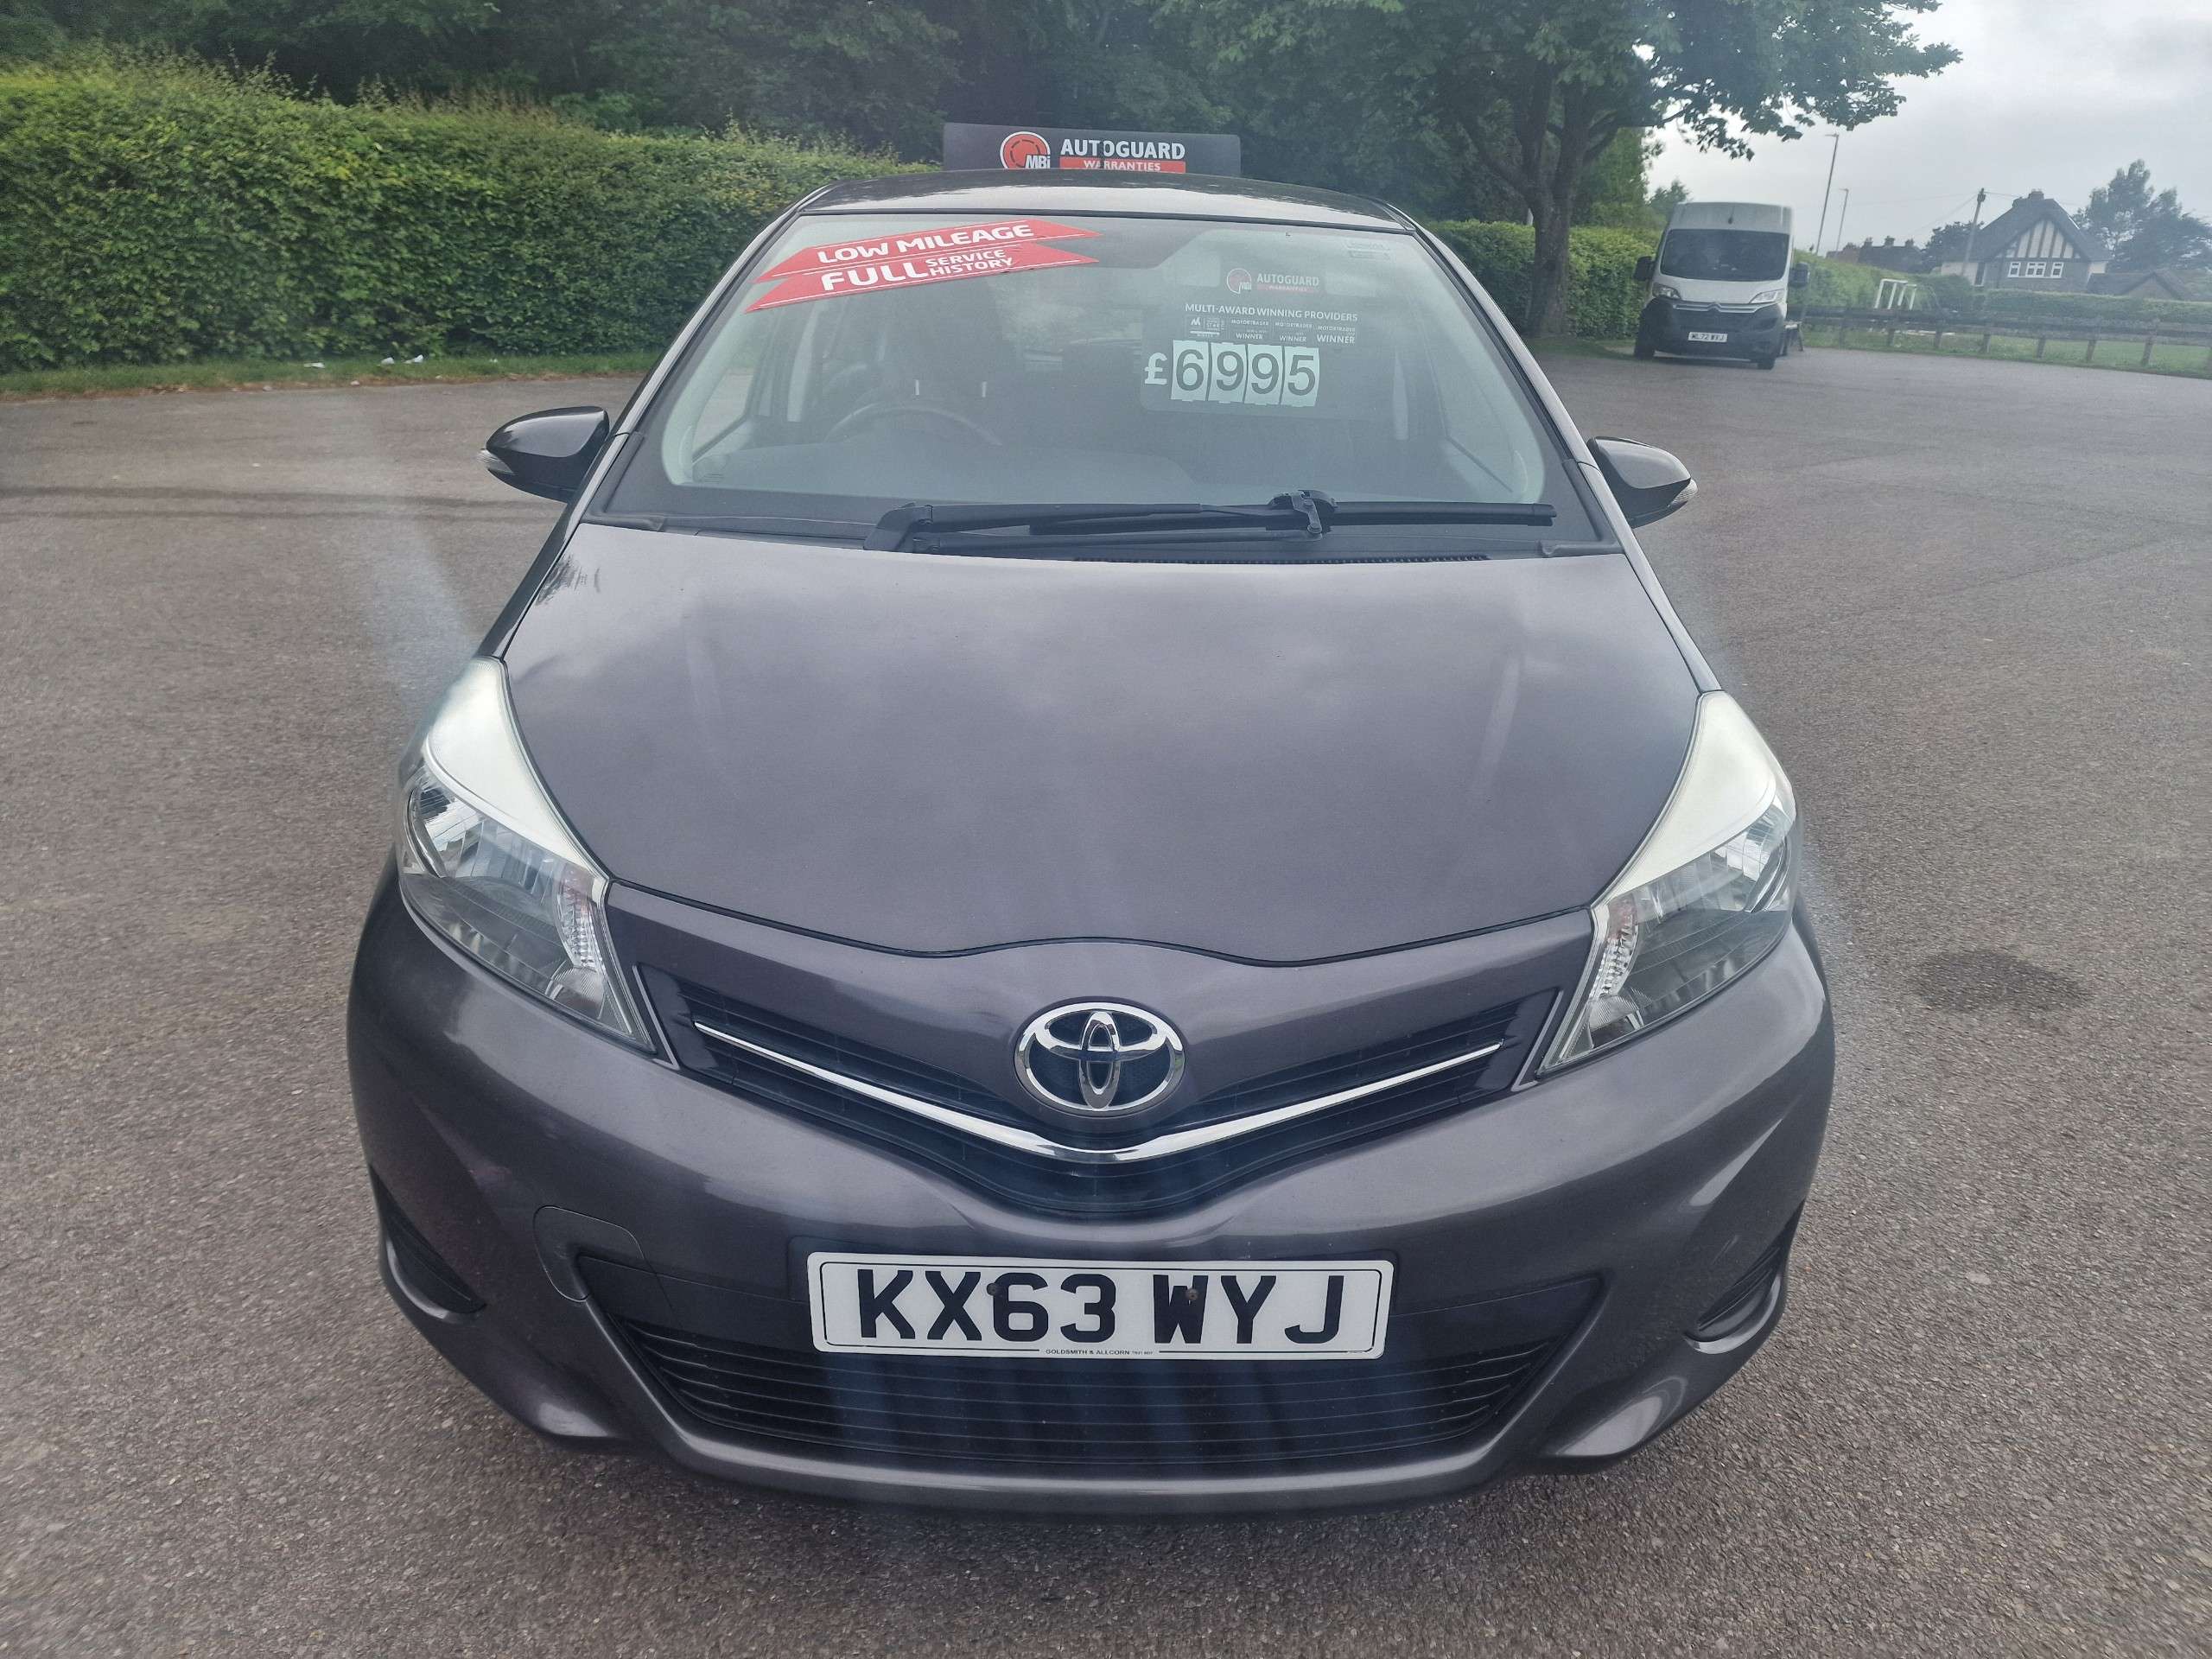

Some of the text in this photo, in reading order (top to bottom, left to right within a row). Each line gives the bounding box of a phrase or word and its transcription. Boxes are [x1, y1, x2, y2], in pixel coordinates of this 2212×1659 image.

[1060, 138, 1185, 160] AUTOGUARD
[1084, 159, 1161, 172] WARRANTIES
[817, 225, 1035, 264] LOW MILEAGE
[925, 249, 1006, 267] SERVICE
[928, 257, 1014, 276] HISTORY
[821, 262, 930, 291] FULL
[1256, 272, 1319, 287] AUTOGUARD
[1185, 303, 1358, 322] MULTI-AWARD WINNING PROVIDERS
[1317, 334, 1356, 344] WINNER
[856, 1268, 1344, 1344] KX63 WYJ
